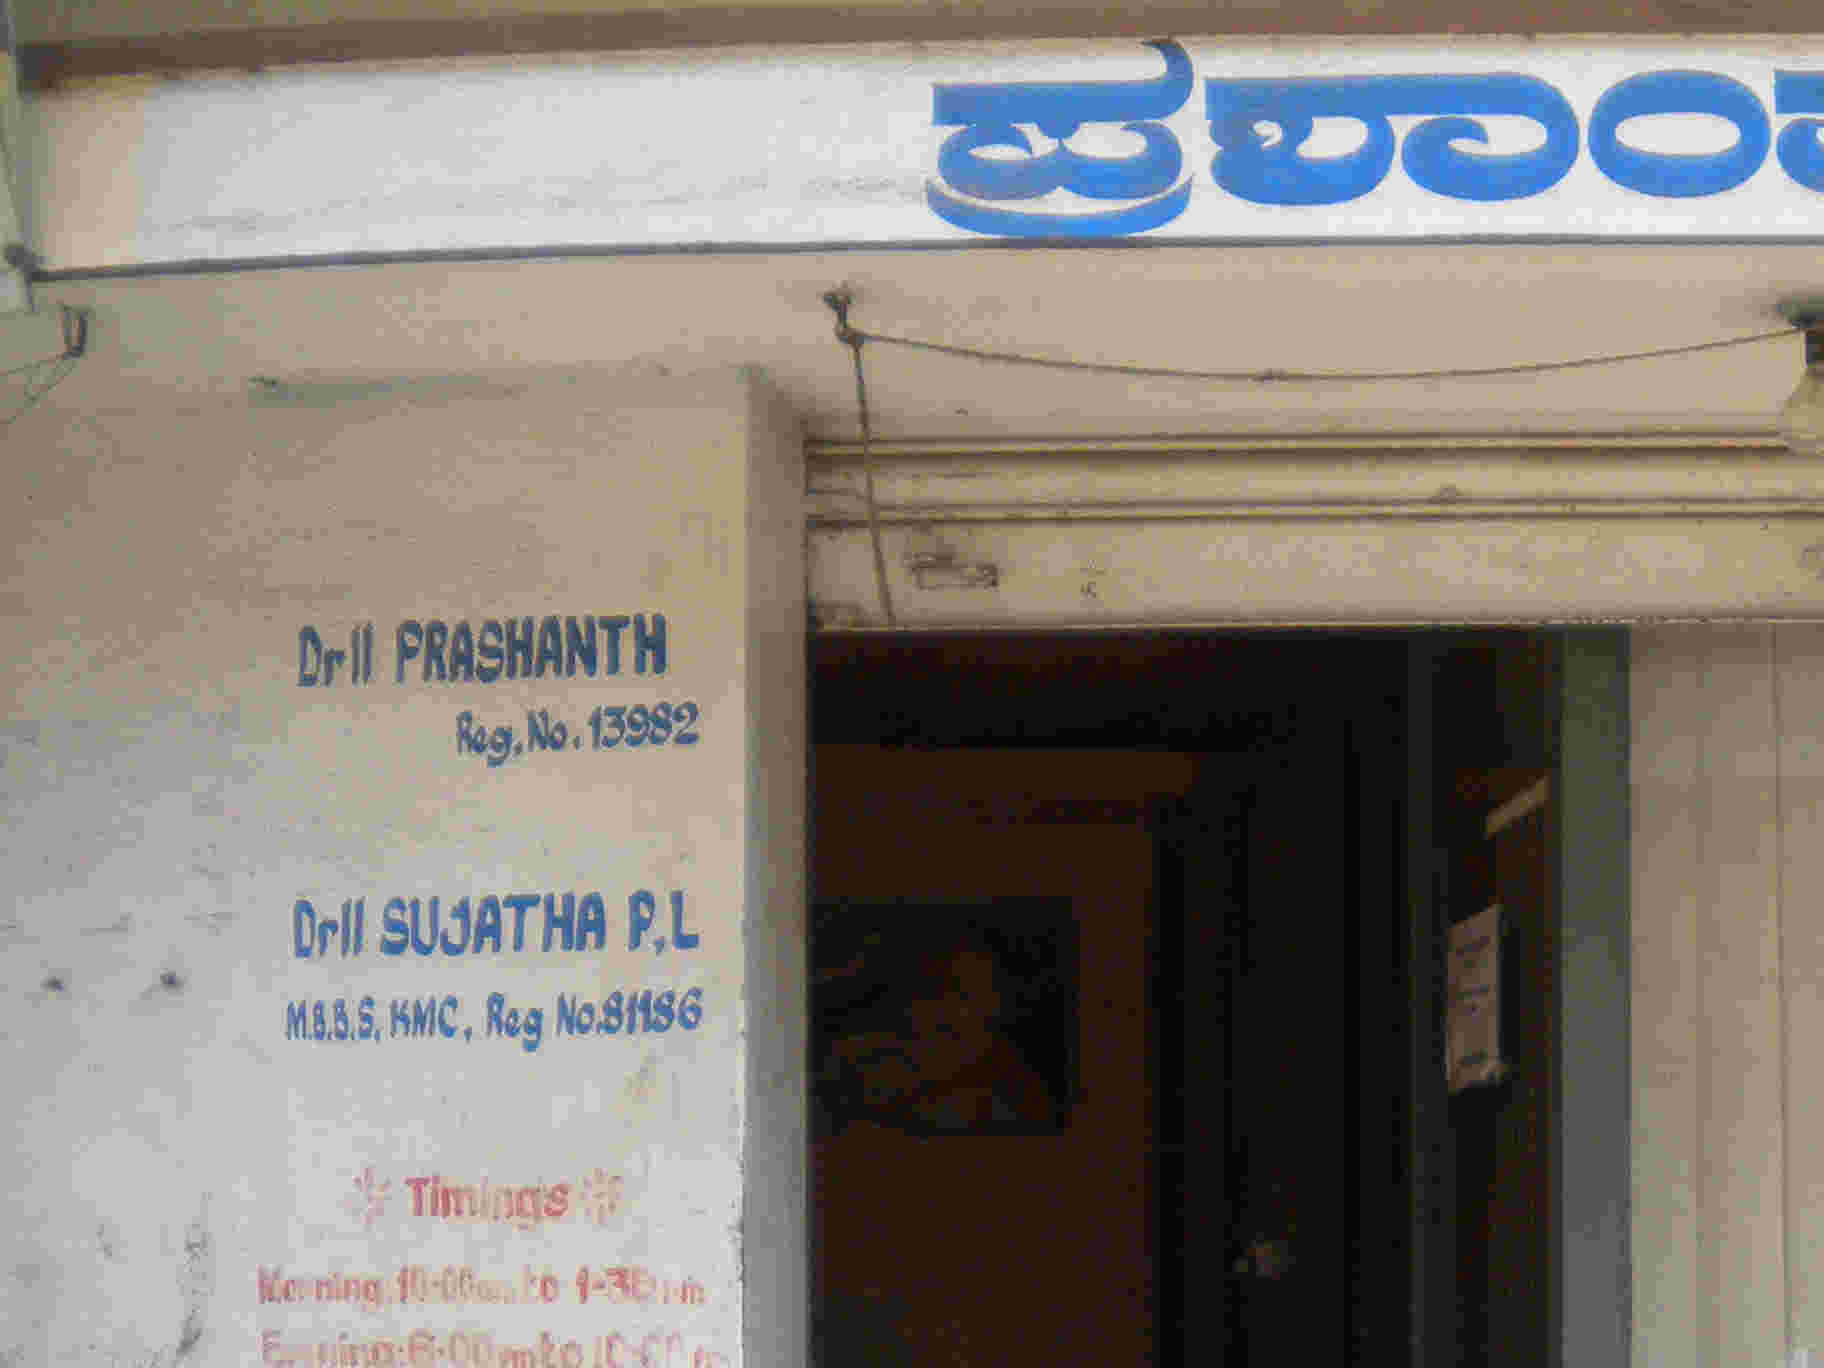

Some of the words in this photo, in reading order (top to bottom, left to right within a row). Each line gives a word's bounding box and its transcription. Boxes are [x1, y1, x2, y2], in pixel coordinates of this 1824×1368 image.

[395, 614, 669, 684] PRASHANTH
[380, 891, 606, 956] SUJATHA
[486, 991, 545, 1053] Reg
